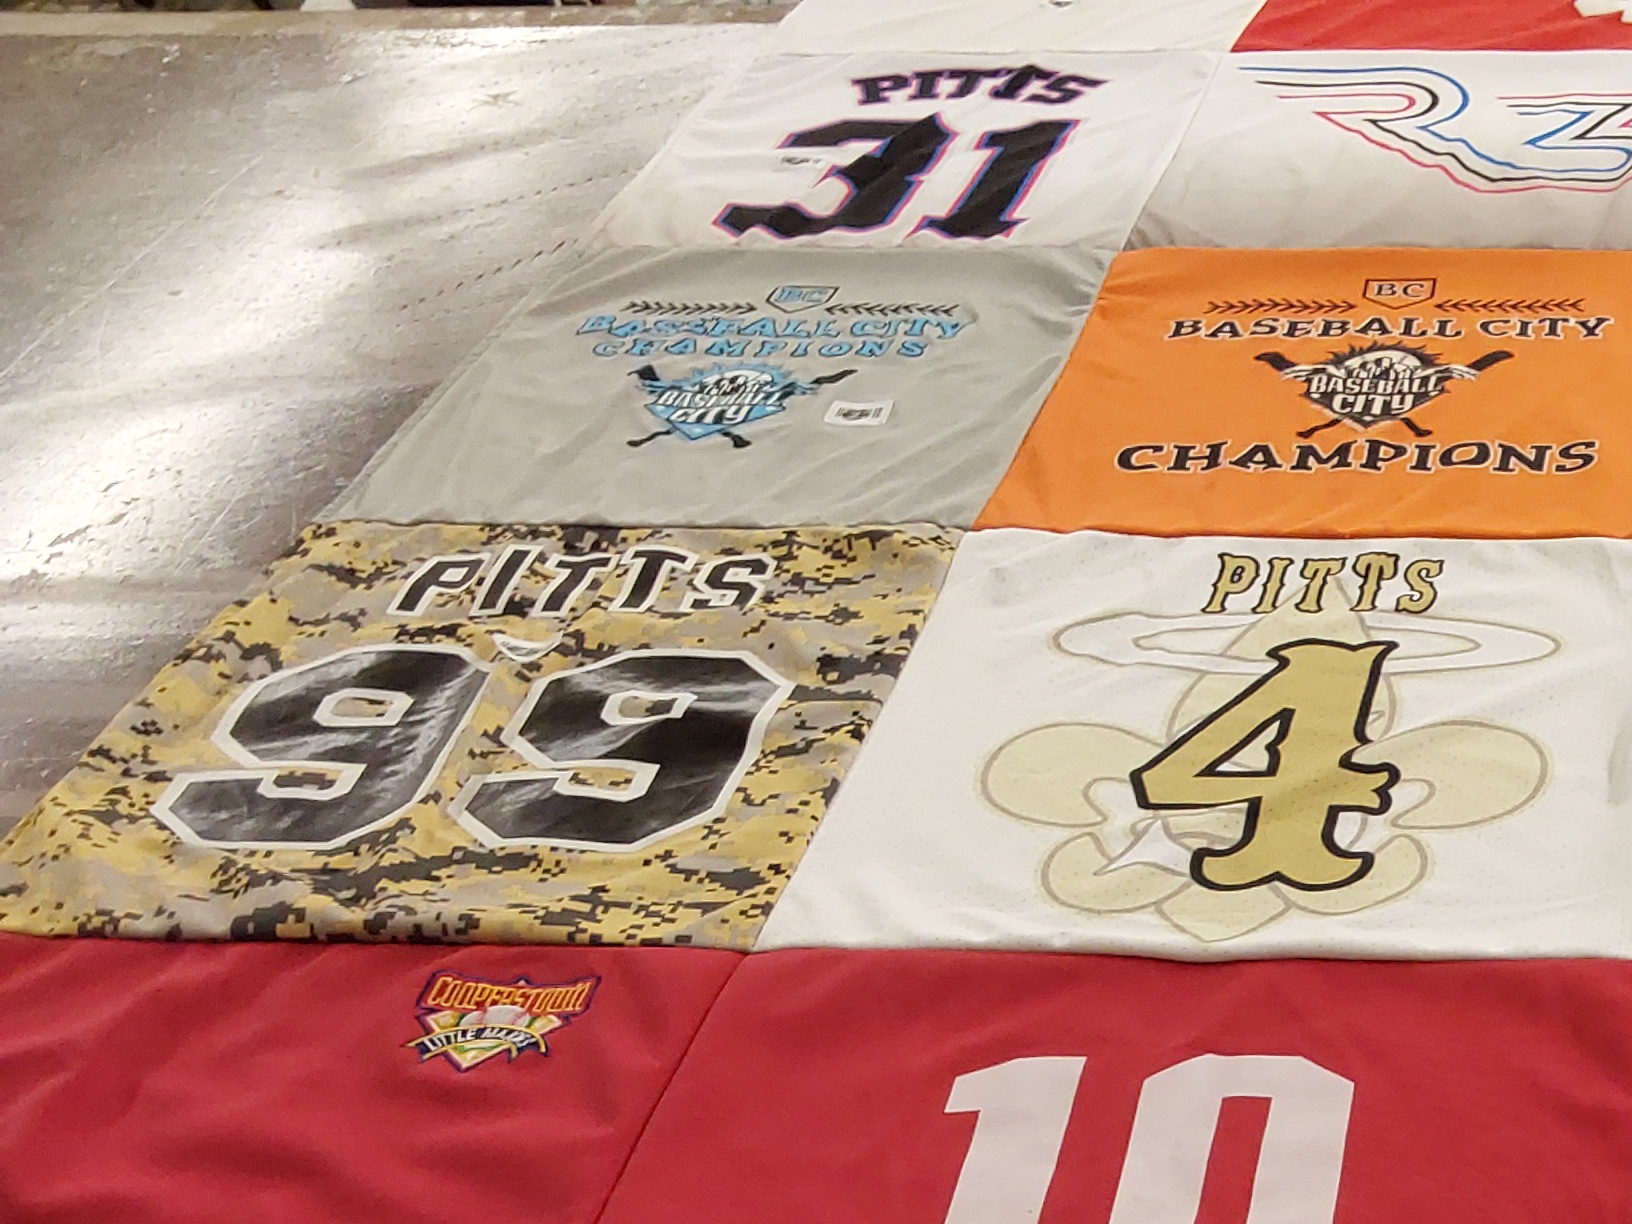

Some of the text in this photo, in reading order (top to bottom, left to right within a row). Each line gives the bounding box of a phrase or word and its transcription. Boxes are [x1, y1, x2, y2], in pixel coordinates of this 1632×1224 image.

[853, 64, 1108, 105] PITTS
[712, 112, 1082, 240] 31
[1372, 282, 1427, 300] BC
[576, 315, 970, 340] BASEBALL CITY
[1168, 317, 1614, 340] BASEBALL CITY
[592, 337, 928, 358] CHAMPIONS
[1308, 373, 1446, 394] BASEBALL
[668, 405, 752, 425] CITY
[1331, 393, 1416, 416] CITY
[1115, 438, 1599, 474] CHAMPIONS
[386, 545, 779, 617] PITTS
[1201, 552, 1444, 615] PITTS
[150, 642, 798, 852] 99
[1129, 637, 1399, 892] 4
[423, 1028, 476, 1051] LITTLE
